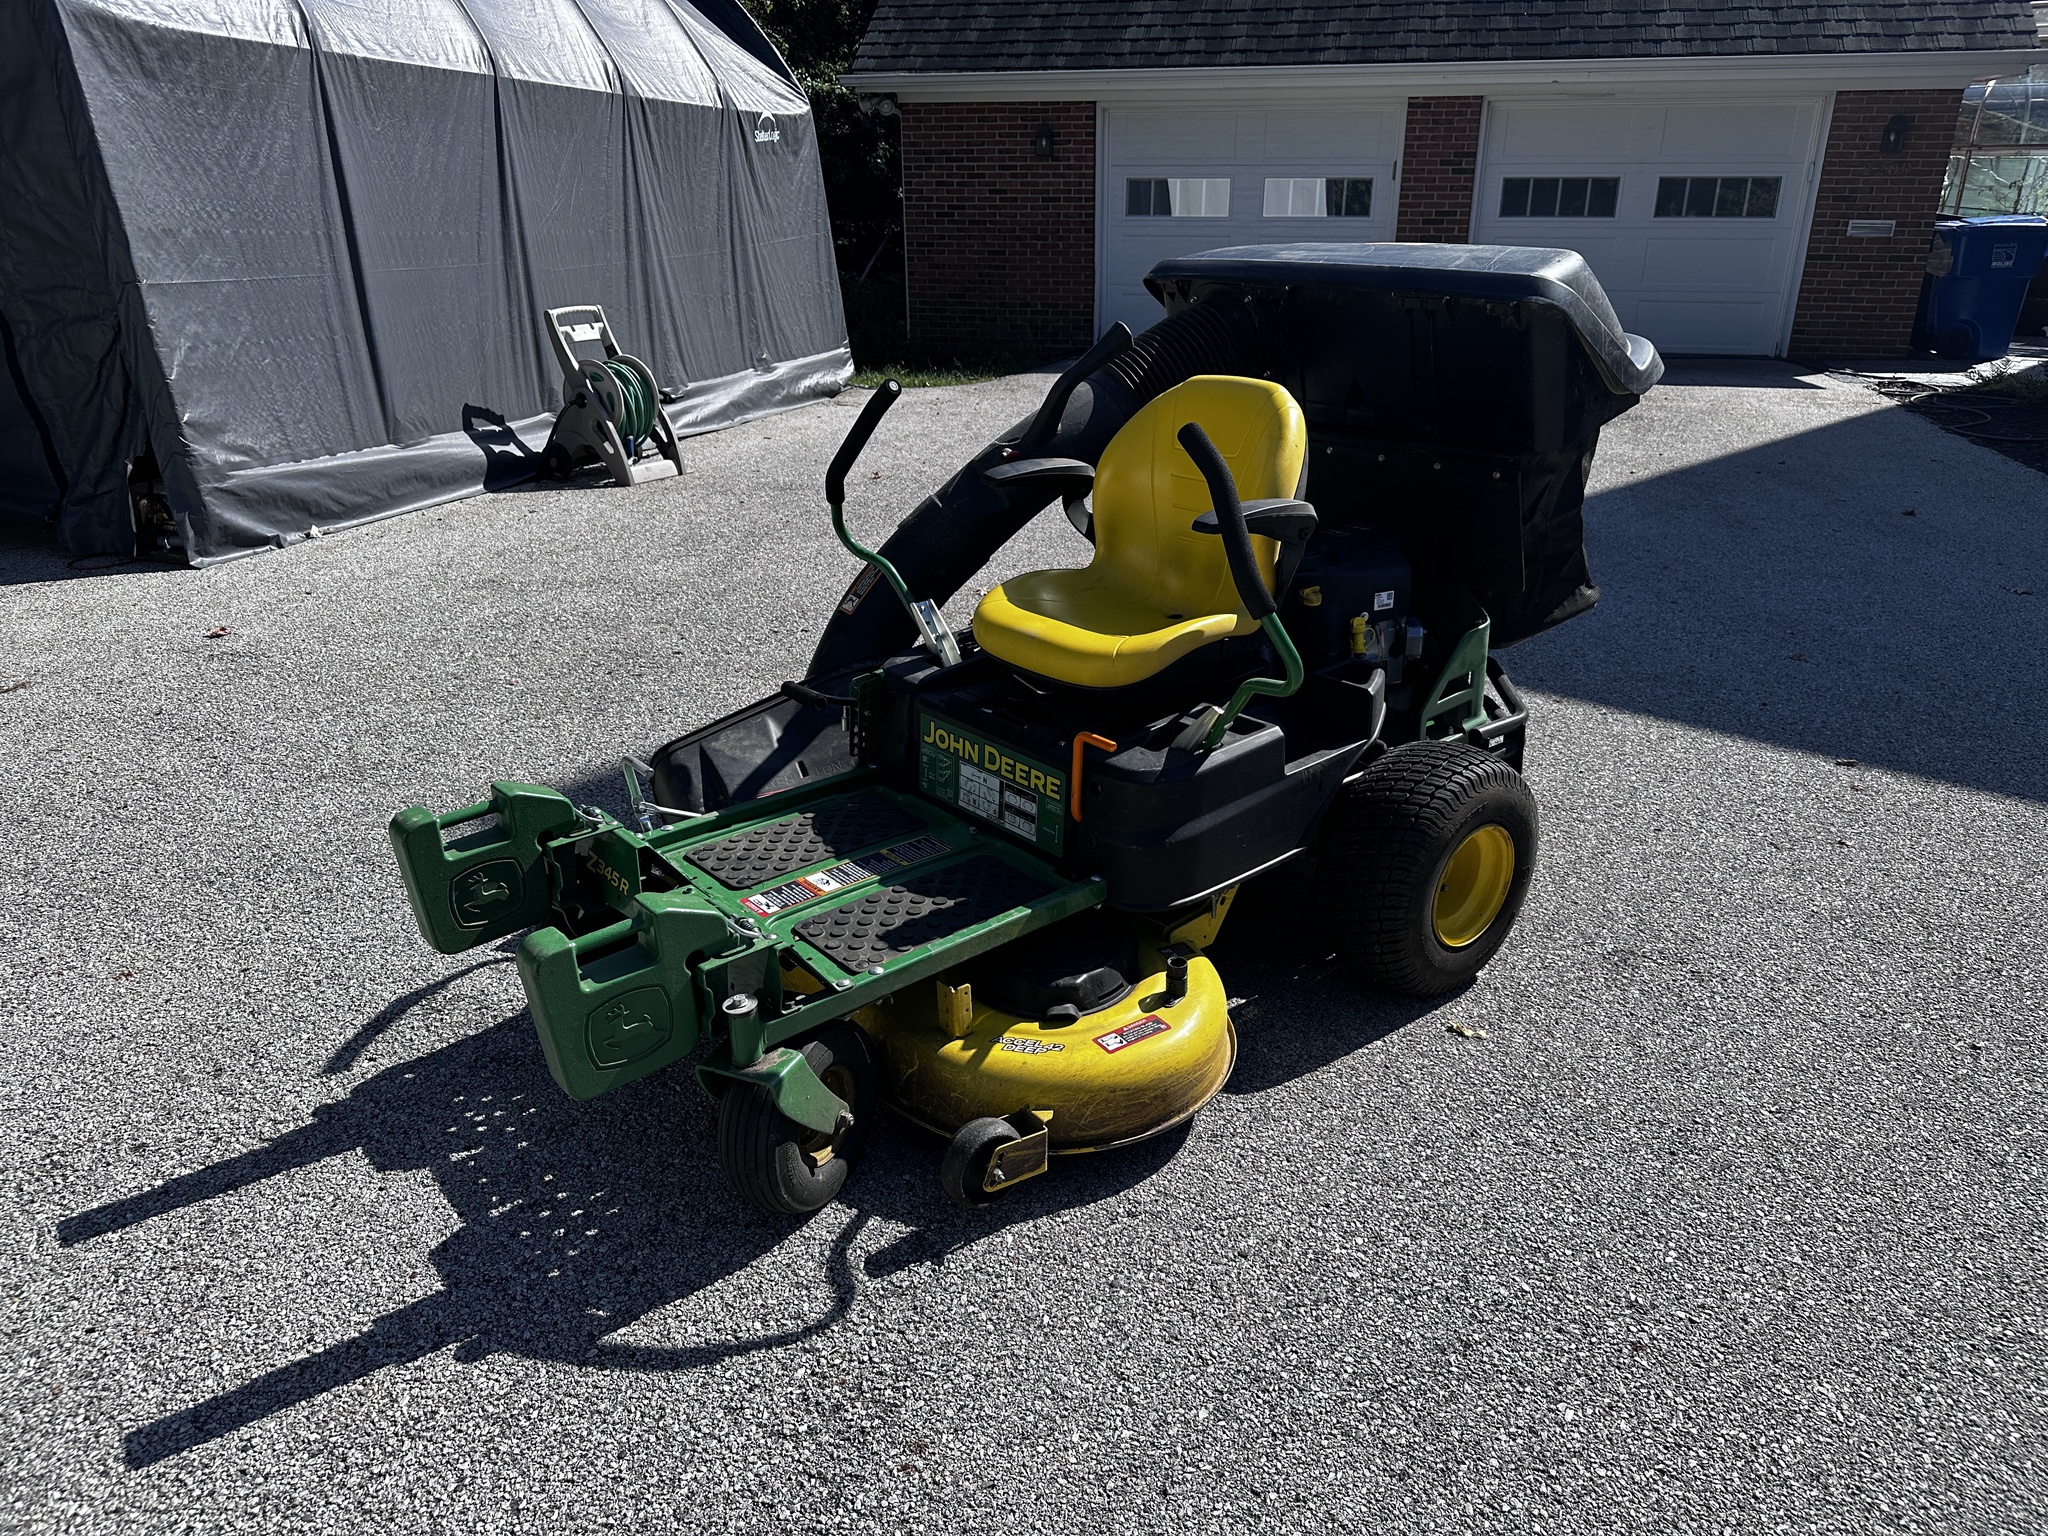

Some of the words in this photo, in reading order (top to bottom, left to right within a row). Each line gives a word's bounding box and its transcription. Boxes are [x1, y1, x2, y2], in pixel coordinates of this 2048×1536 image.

[923, 721, 979, 764] JOHN
[984, 744, 1061, 800] DEERE
[586, 849, 630, 896] Z345R
[988, 1035, 1045, 1048] ACCEL
[1002, 1043, 1047, 1055] DEEP
[1045, 1043, 1066, 1053] 42
